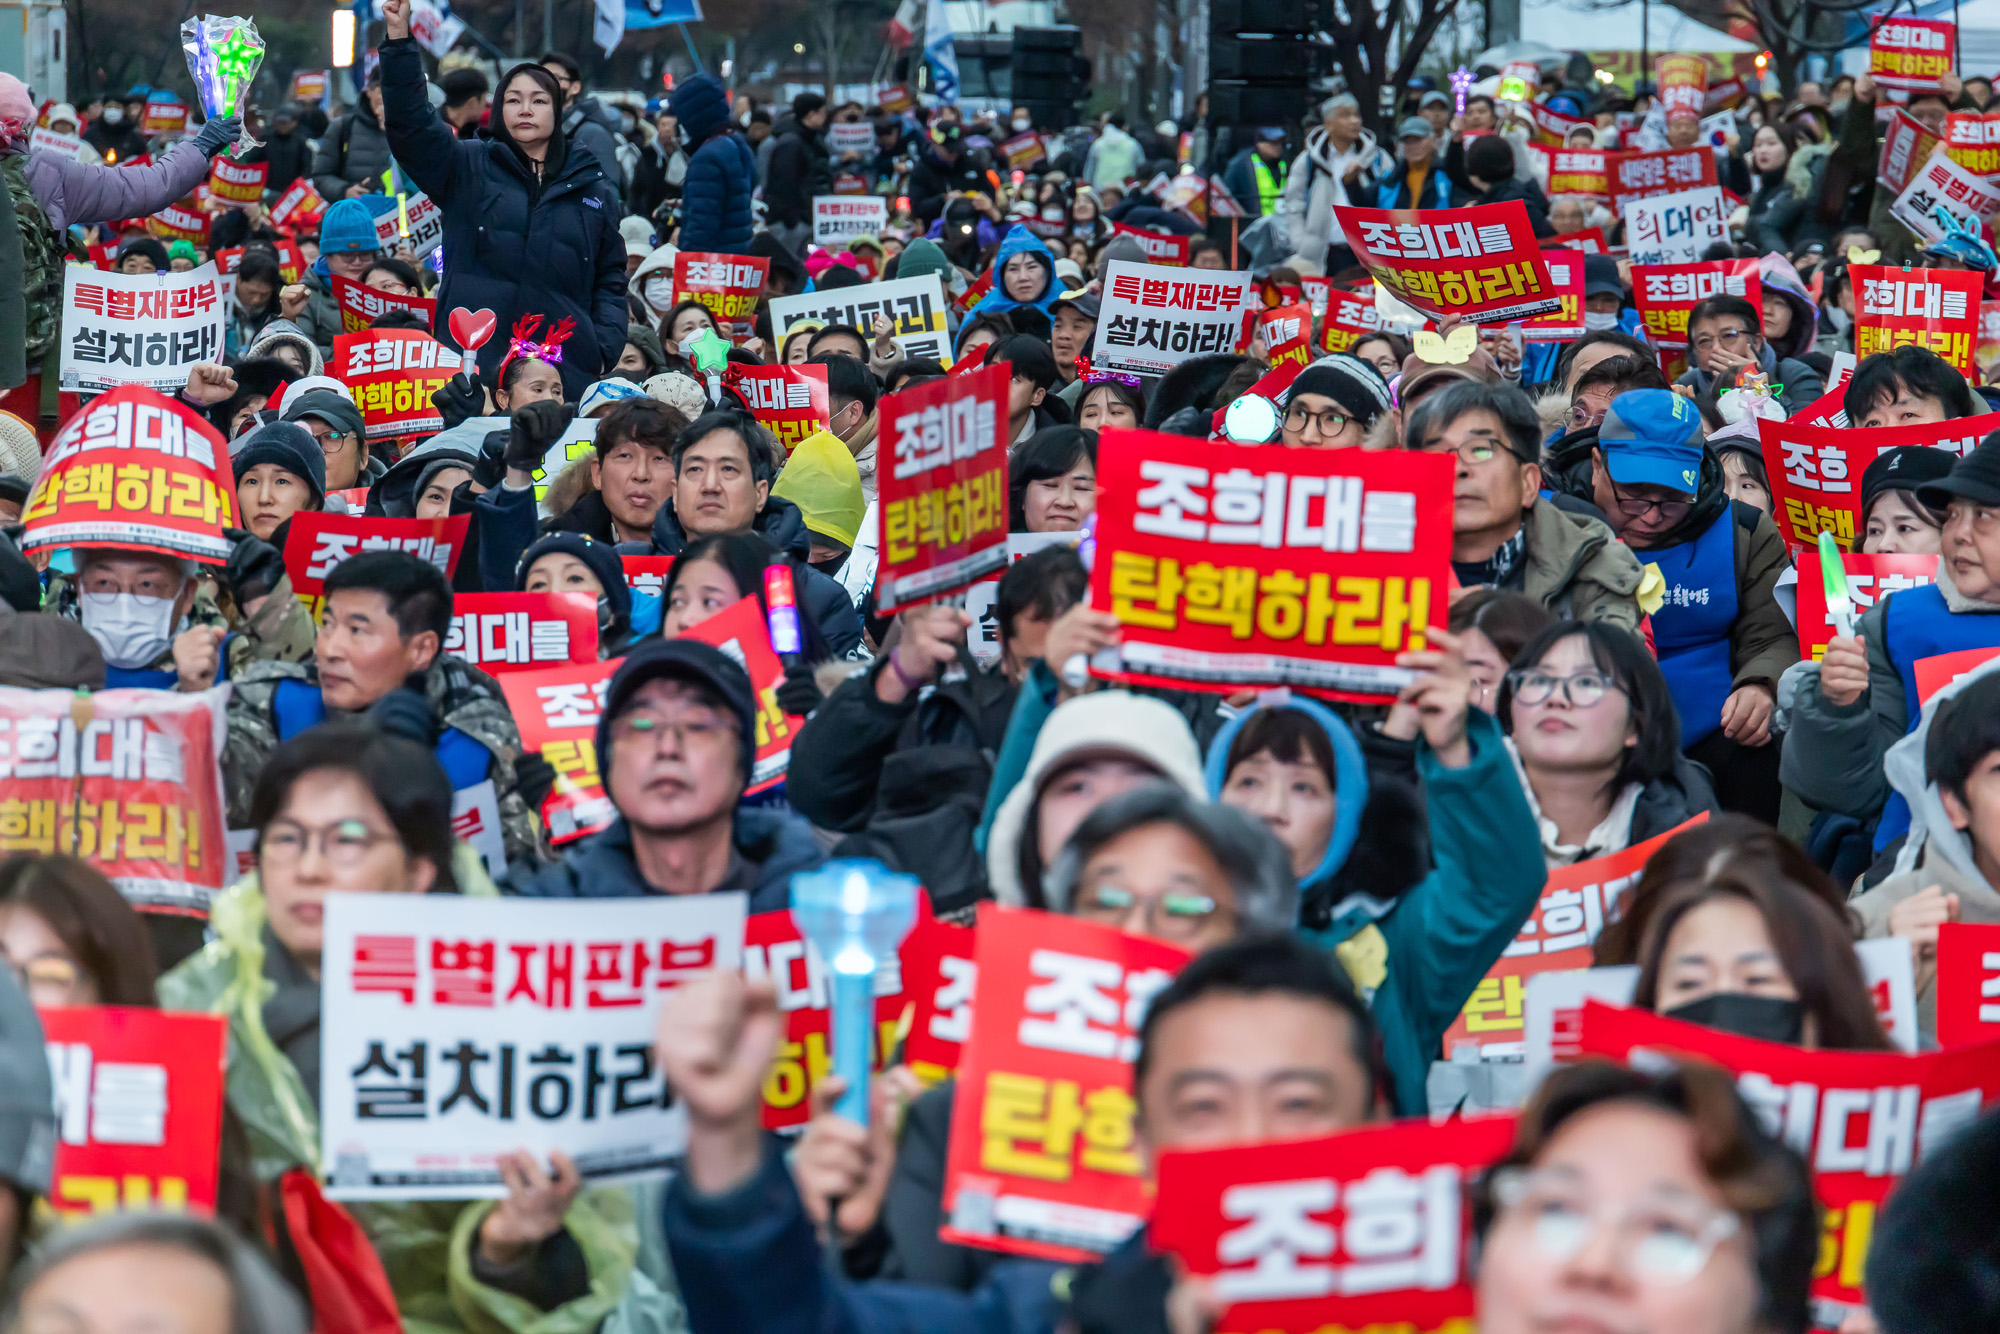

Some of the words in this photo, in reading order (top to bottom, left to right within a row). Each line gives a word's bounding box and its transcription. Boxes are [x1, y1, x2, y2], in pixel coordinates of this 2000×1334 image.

[1875, 24, 1946, 51] 조희대를
[1358, 221, 1514, 260] 조희대를
[685, 261, 763, 289] 조희대를
[1112, 274, 1243, 312] 특별재판부
[1367, 260, 1542, 307] 탄핵하라!
[1645, 271, 1746, 302] 조희대를
[74, 279, 217, 321] 특별재판부
[1863, 279, 1967, 319] 조희대를
[72, 323, 217, 368] 설치하라!
[1106, 314, 1235, 353] 설치하라!
[346, 339, 462, 377] 조희대를
[46, 401, 216, 471] 조희대를
[893, 395, 997, 480] 조희대를
[19, 463, 233, 529] 탄핵하라!
[885, 467, 1003, 565] 탄핵하라!
[1133, 460, 1417, 553] 조희대를
[1110, 550, 1430, 651] 탄핵하라!
[1673, 583, 1710, 607] 촛불행동
